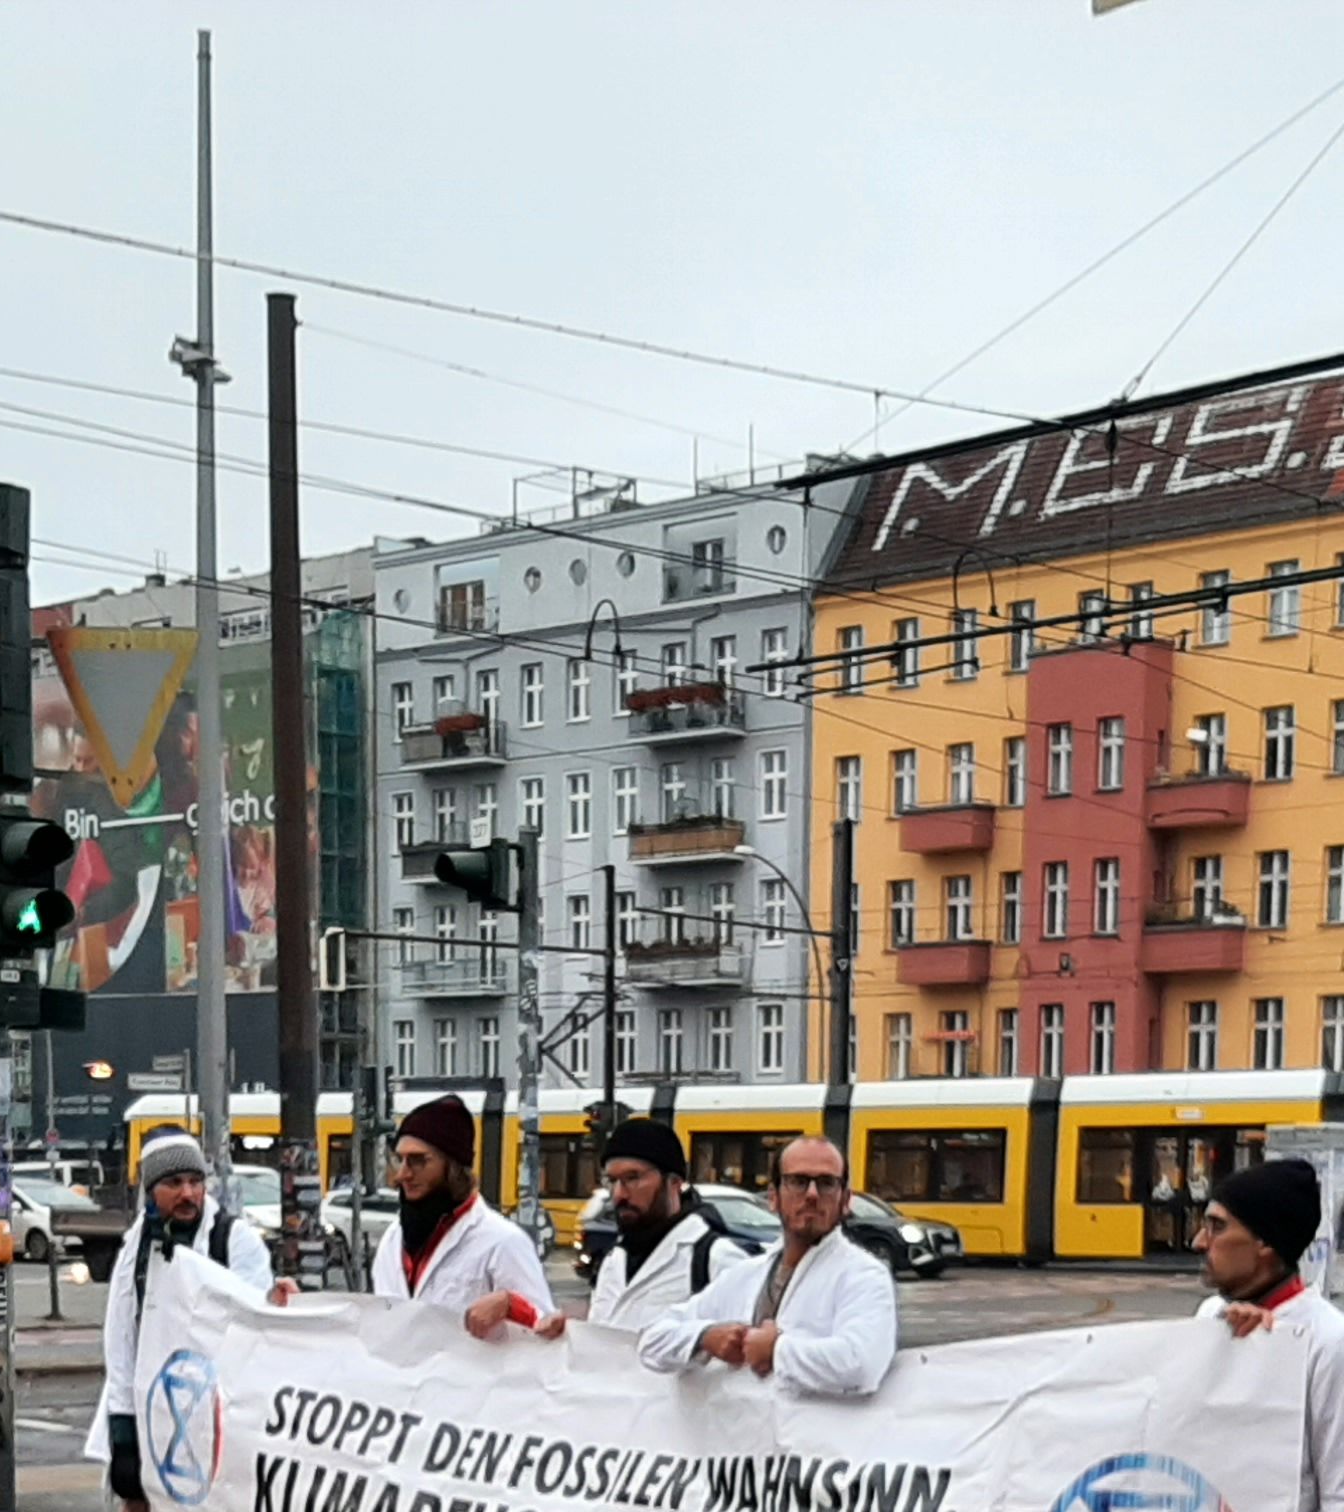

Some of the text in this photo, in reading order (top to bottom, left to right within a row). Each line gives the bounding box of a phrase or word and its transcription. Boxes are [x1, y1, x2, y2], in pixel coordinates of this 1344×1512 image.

[65, 808, 99, 839] Bin
[265, 1386, 422, 1463] STOPPT
[422, 1422, 513, 1484] DEN
[508, 1436, 699, 1511] FOSSILEN
